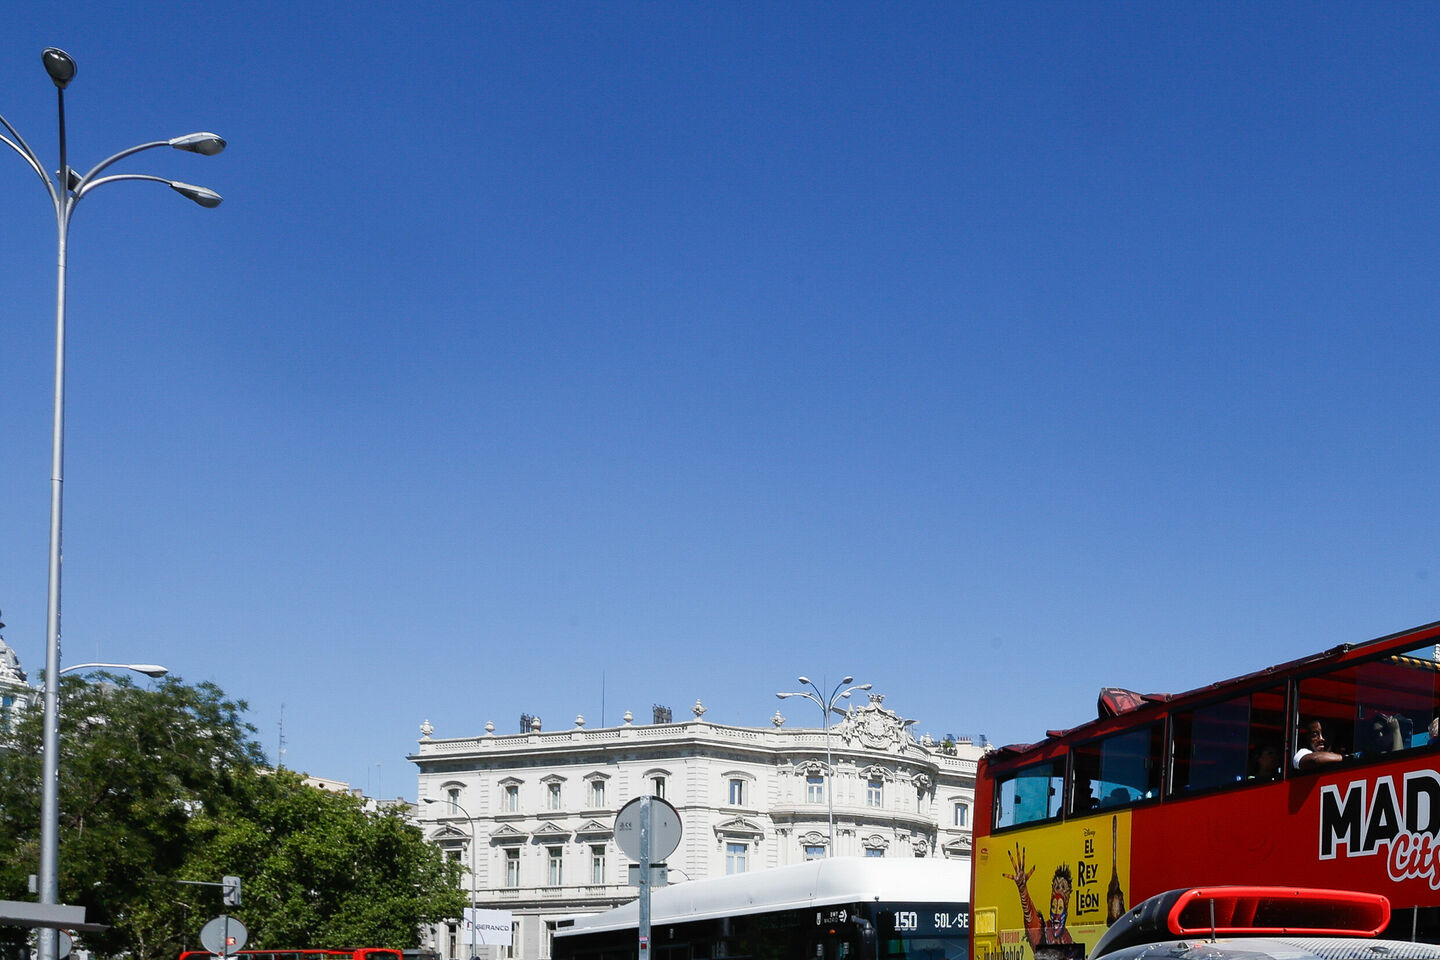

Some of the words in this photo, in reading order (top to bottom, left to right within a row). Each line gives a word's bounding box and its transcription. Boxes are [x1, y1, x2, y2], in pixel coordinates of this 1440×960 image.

[1084, 839, 1094, 854] EL
[894, 911, 918, 928] 150
[934, 912, 969, 929] SOL/SE
